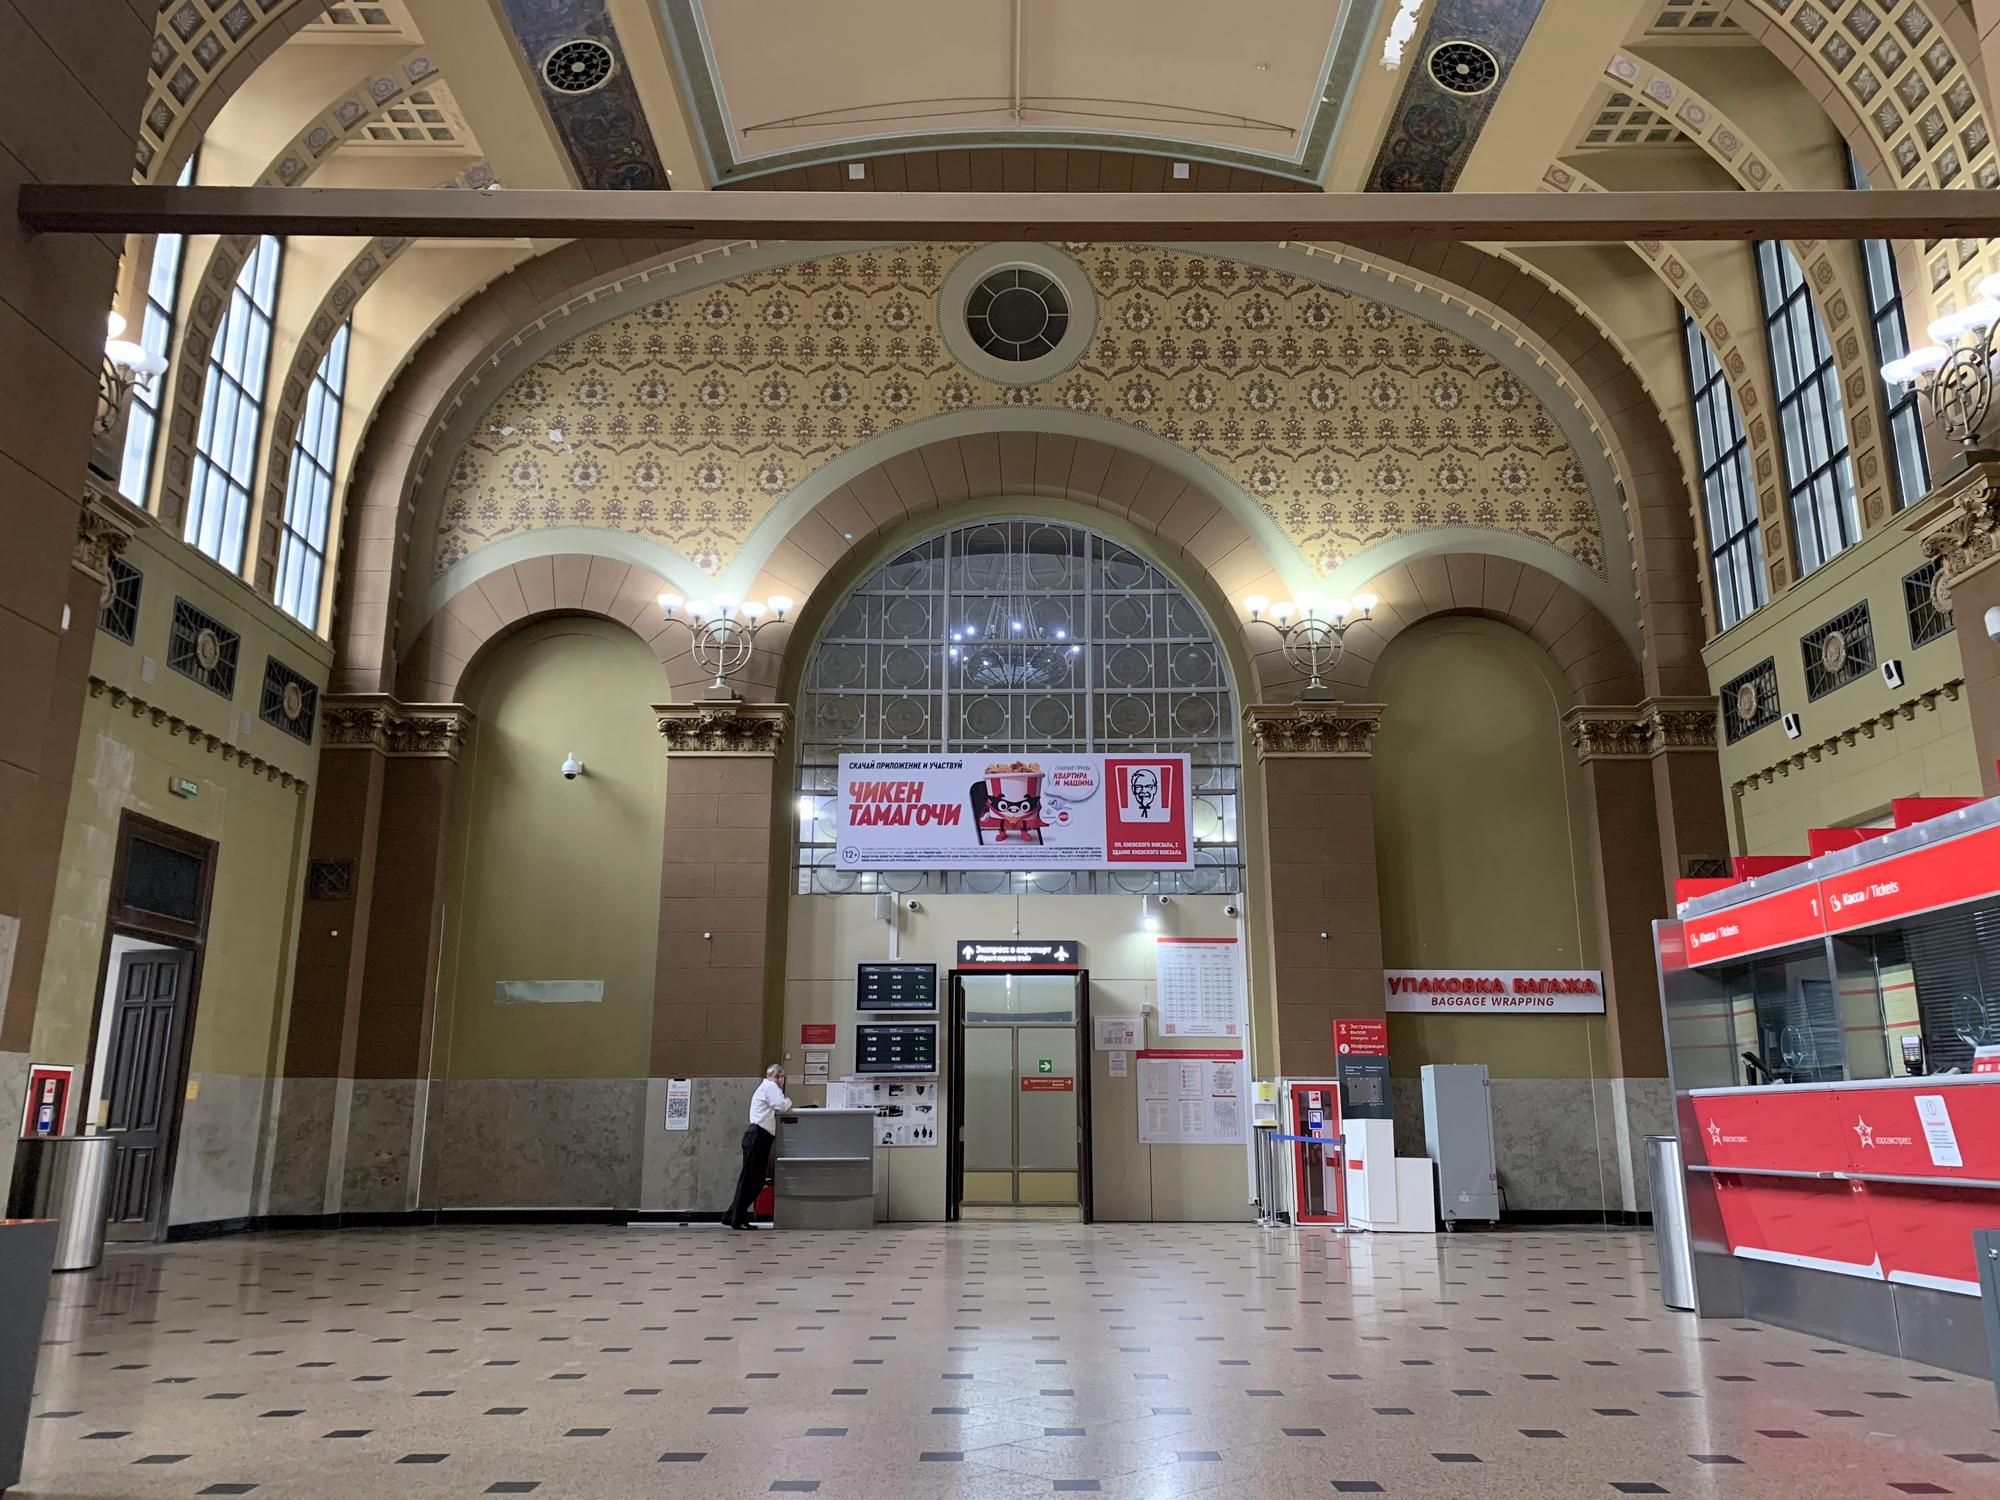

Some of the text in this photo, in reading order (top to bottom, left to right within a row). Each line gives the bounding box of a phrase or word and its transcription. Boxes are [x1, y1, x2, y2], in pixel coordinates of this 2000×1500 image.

[849, 759, 963, 770] СКАЧАЙ ПРИЛОЖЕНИЕ И УЧАСТВУЙ
[1053, 772, 1087, 780] КВАРТИРА
[1054, 779, 1094, 787] И МАШИНА
[849, 781, 924, 803] ЧИКЕН
[849, 803, 962, 826] ТАМАГОЧИ
[844, 850, 858, 859] 12+
[1842, 890, 1866, 907] Касса
[1870, 880, 1900, 899] Tickets
[1811, 898, 1819, 917] 1
[1699, 931, 1716, 944] Касса
[1719, 924, 1739, 938] Tickets
[1016, 946, 1052, 956] аэропорт
[1388, 976, 1597, 995] УПАКОВКА БАГАЖА
[1431, 997, 1554, 1007] BAGGAGE WRAPPING
